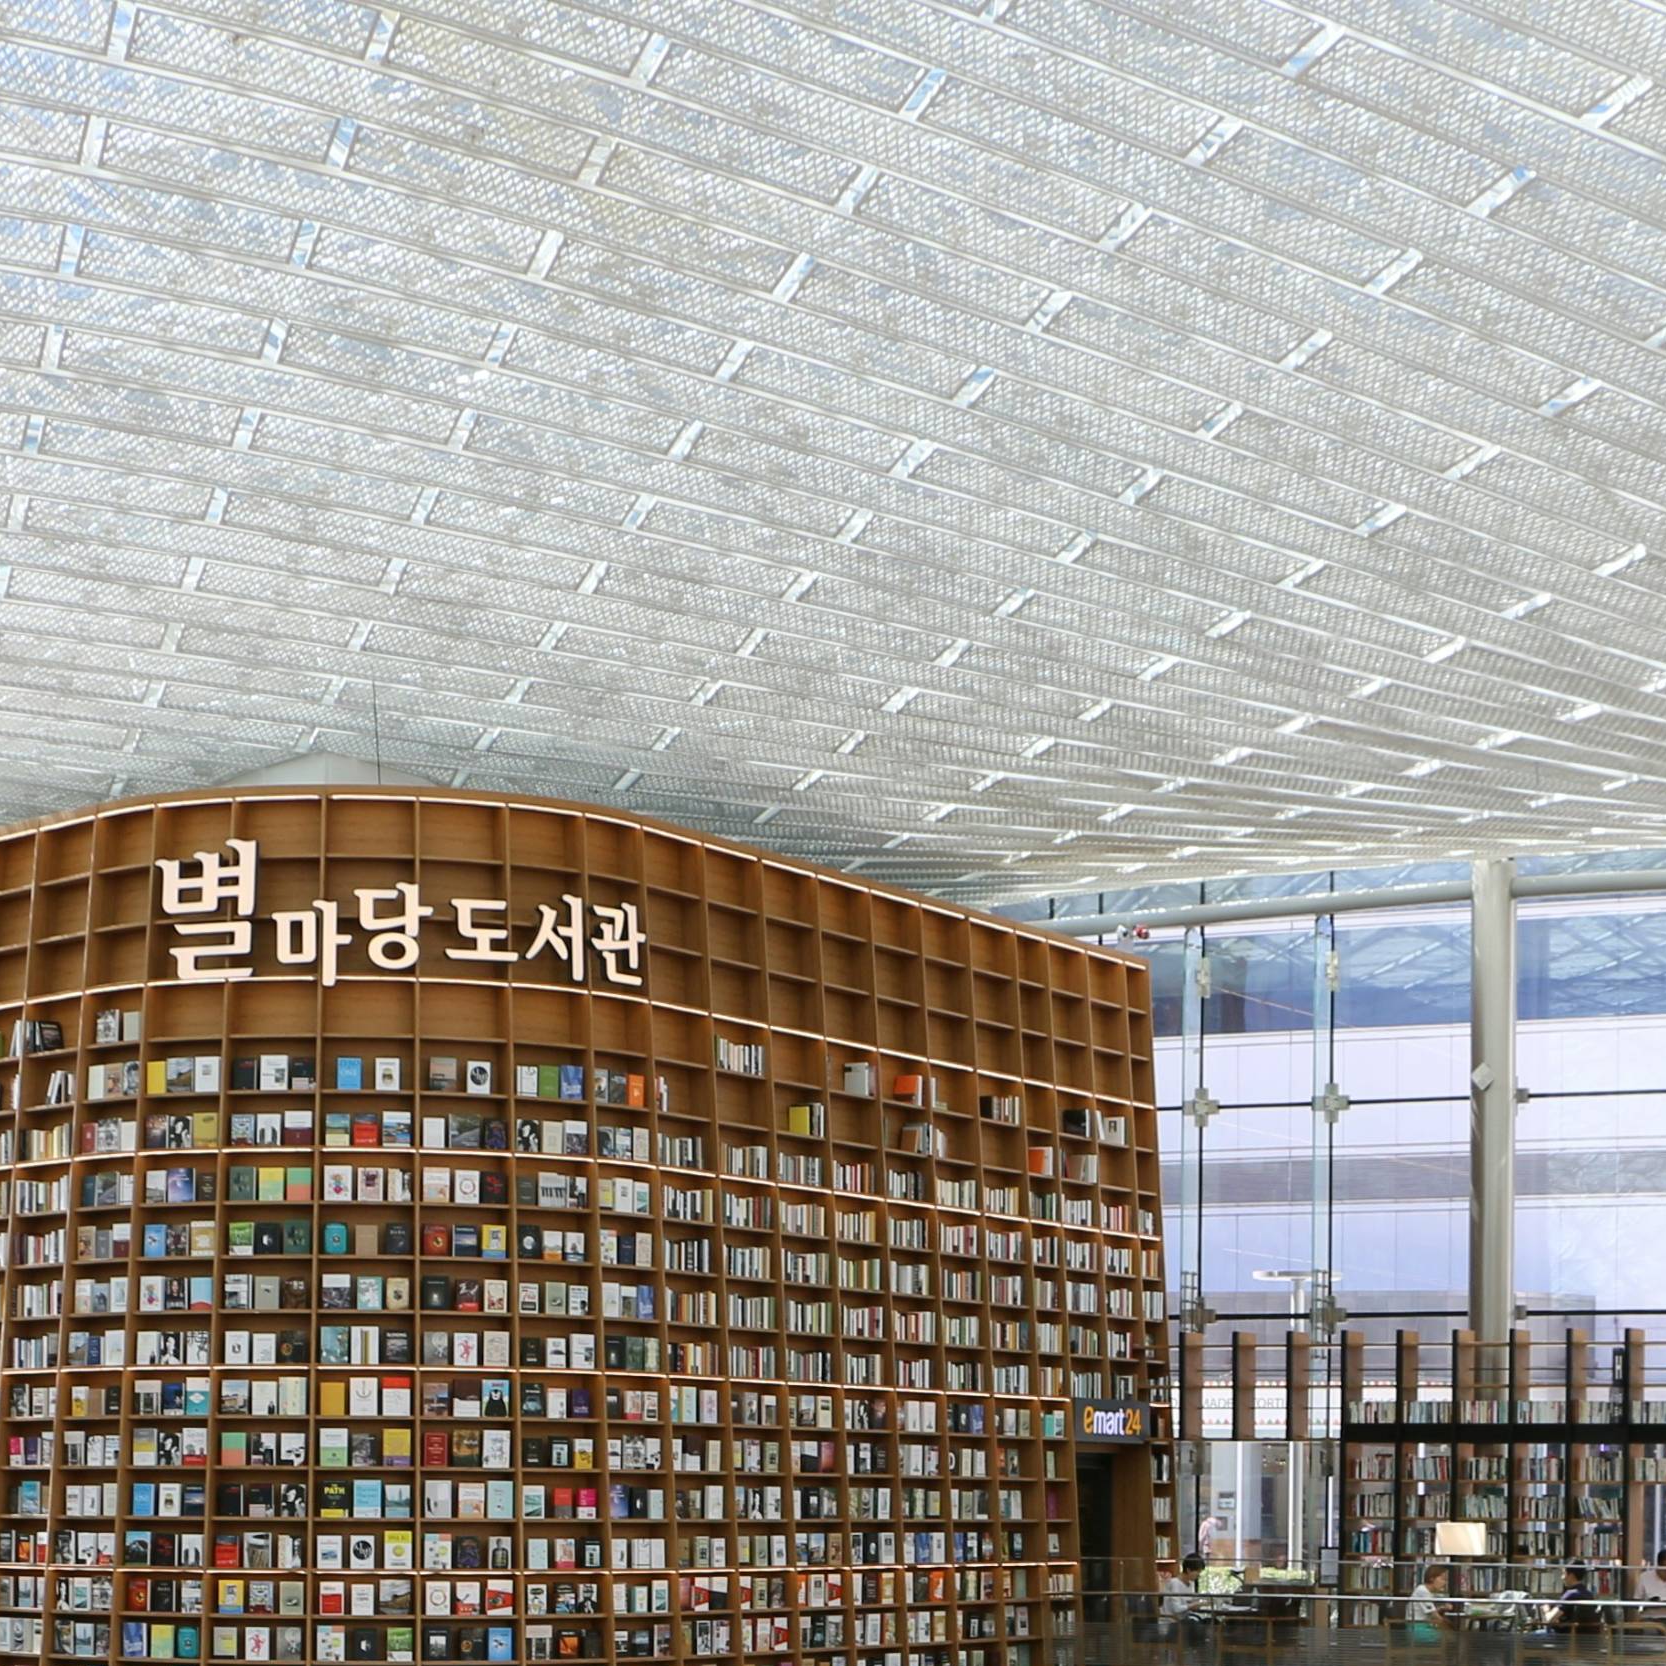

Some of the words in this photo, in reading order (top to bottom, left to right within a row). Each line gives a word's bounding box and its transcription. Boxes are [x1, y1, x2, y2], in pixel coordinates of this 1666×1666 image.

[154, 838, 433, 987] 별마당
[445, 893, 647, 986] 도서관
[1614, 1354, 1623, 1380] H
[1084, 1406, 1141, 1436] emart24
